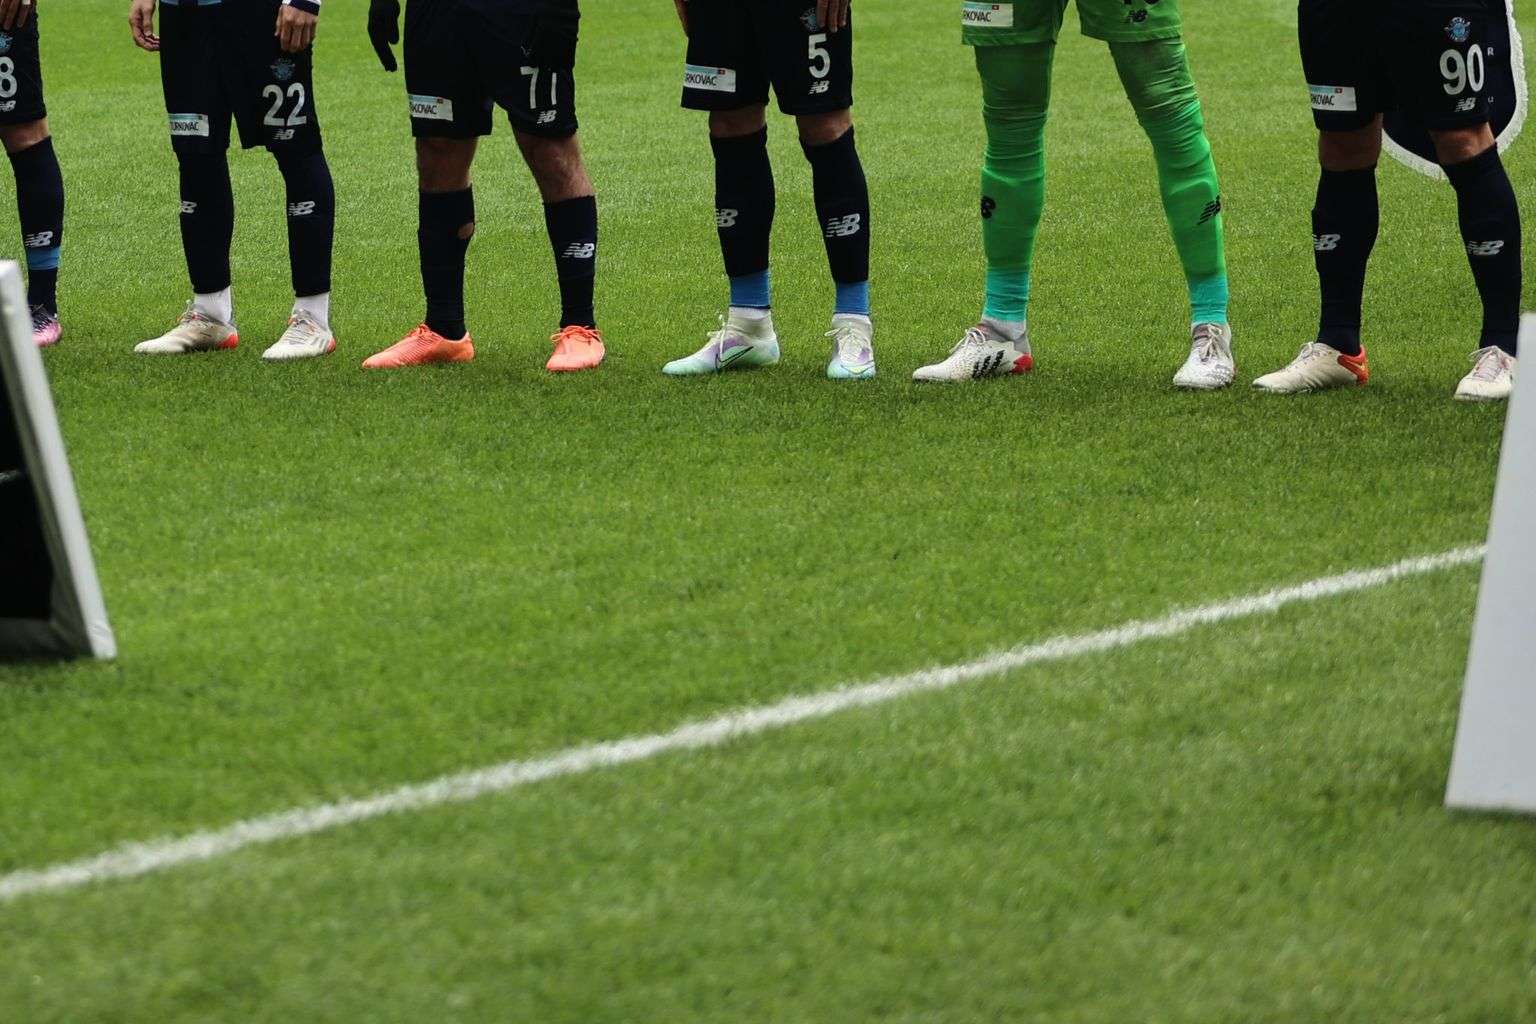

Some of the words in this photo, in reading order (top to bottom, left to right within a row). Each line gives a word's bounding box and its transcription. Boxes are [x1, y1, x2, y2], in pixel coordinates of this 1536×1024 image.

[808, 33, 831, 79] 5
[1439, 43, 1485, 96] 90
[262, 82, 307, 127] 22
